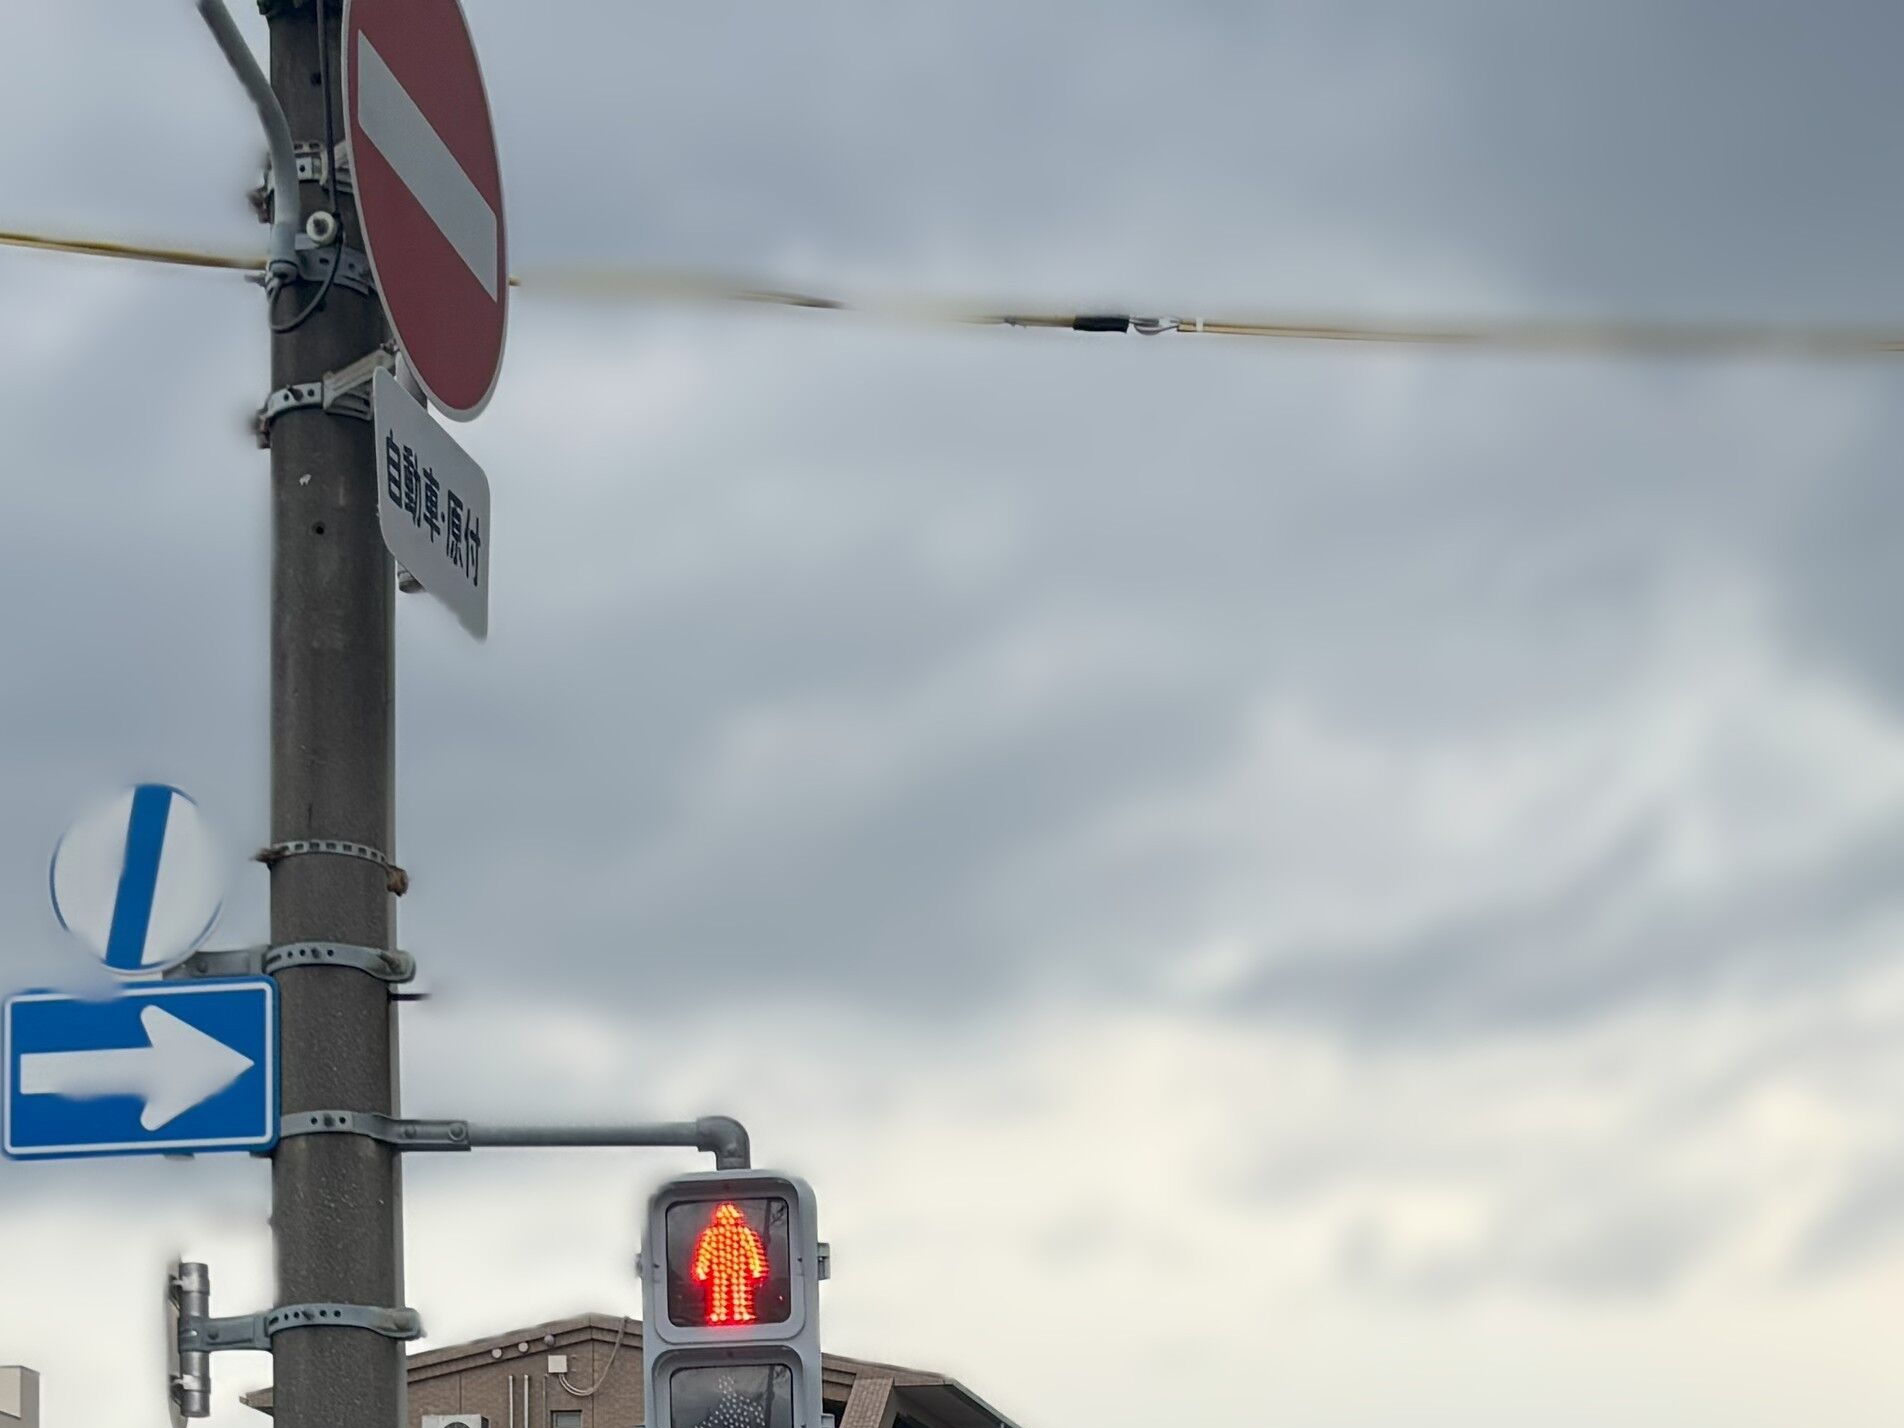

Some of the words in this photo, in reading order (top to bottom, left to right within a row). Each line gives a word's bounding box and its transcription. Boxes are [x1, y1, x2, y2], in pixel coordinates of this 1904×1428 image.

[386, 428, 481, 587] 自動車・原付
